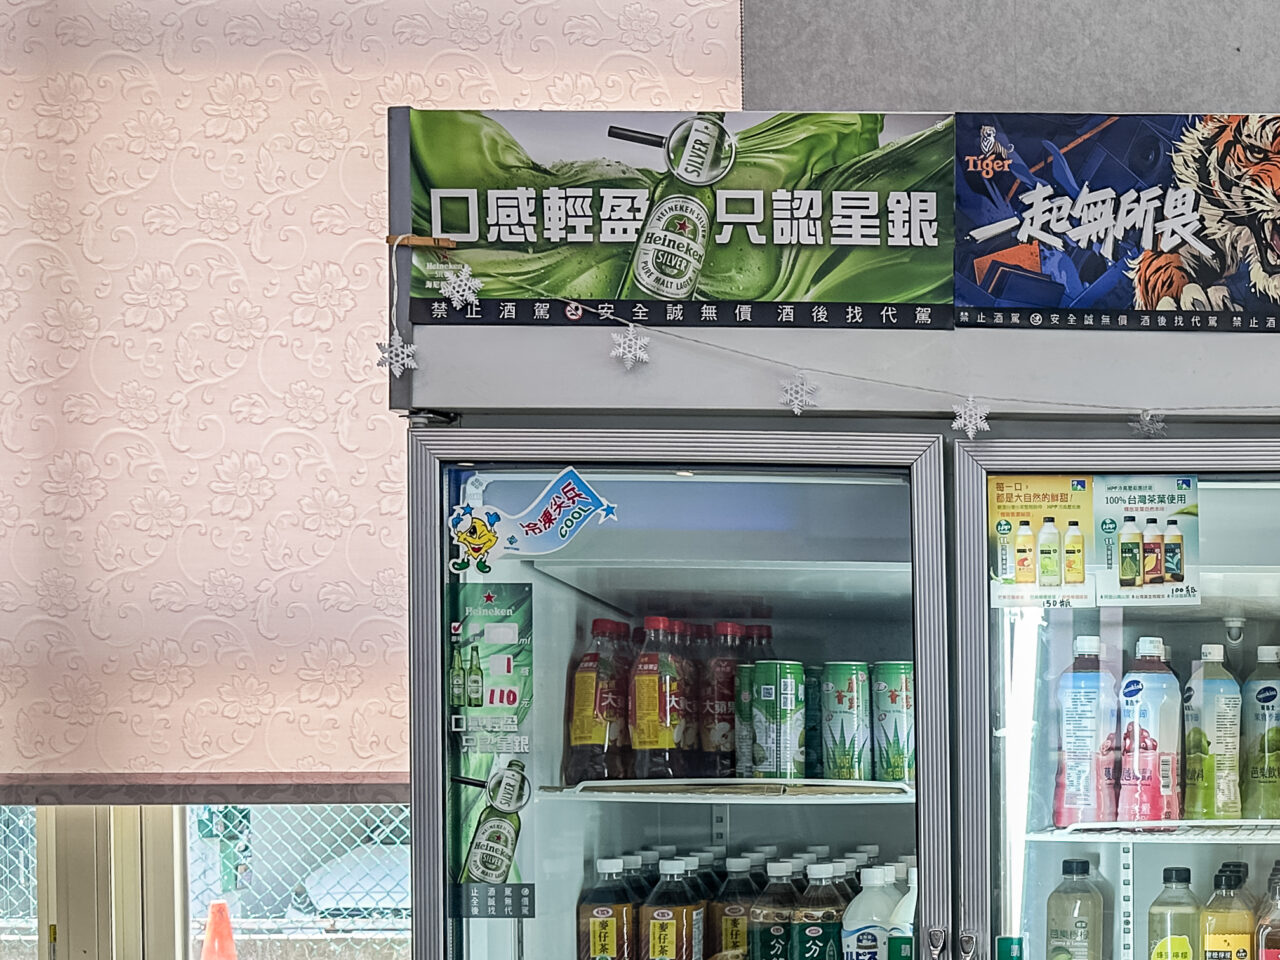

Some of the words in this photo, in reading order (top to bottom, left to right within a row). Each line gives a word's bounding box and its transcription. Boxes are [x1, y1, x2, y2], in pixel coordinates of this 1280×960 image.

[684, 139, 710, 178] SILVER
[965, 154, 1012, 179] Tiger
[430, 187, 651, 245] 口感輕盈
[656, 204, 696, 223] HEINEKEN
[714, 189, 940, 247] 只認星銀
[656, 250, 688, 273] SILVER
[653, 274, 674, 291] MALT
[599, 302, 753, 323] 安全誠無價
[776, 304, 933, 325] 酒後找代駕
[959, 310, 1022, 325] 禁止酒駕
[1050, 312, 1128, 327] 安全誠無價
[1140, 314, 1219, 329] 酒後找代駕
[557, 504, 592, 540] COOL
[465, 606, 514, 617] Heineken
[488, 688, 518, 706] 110
